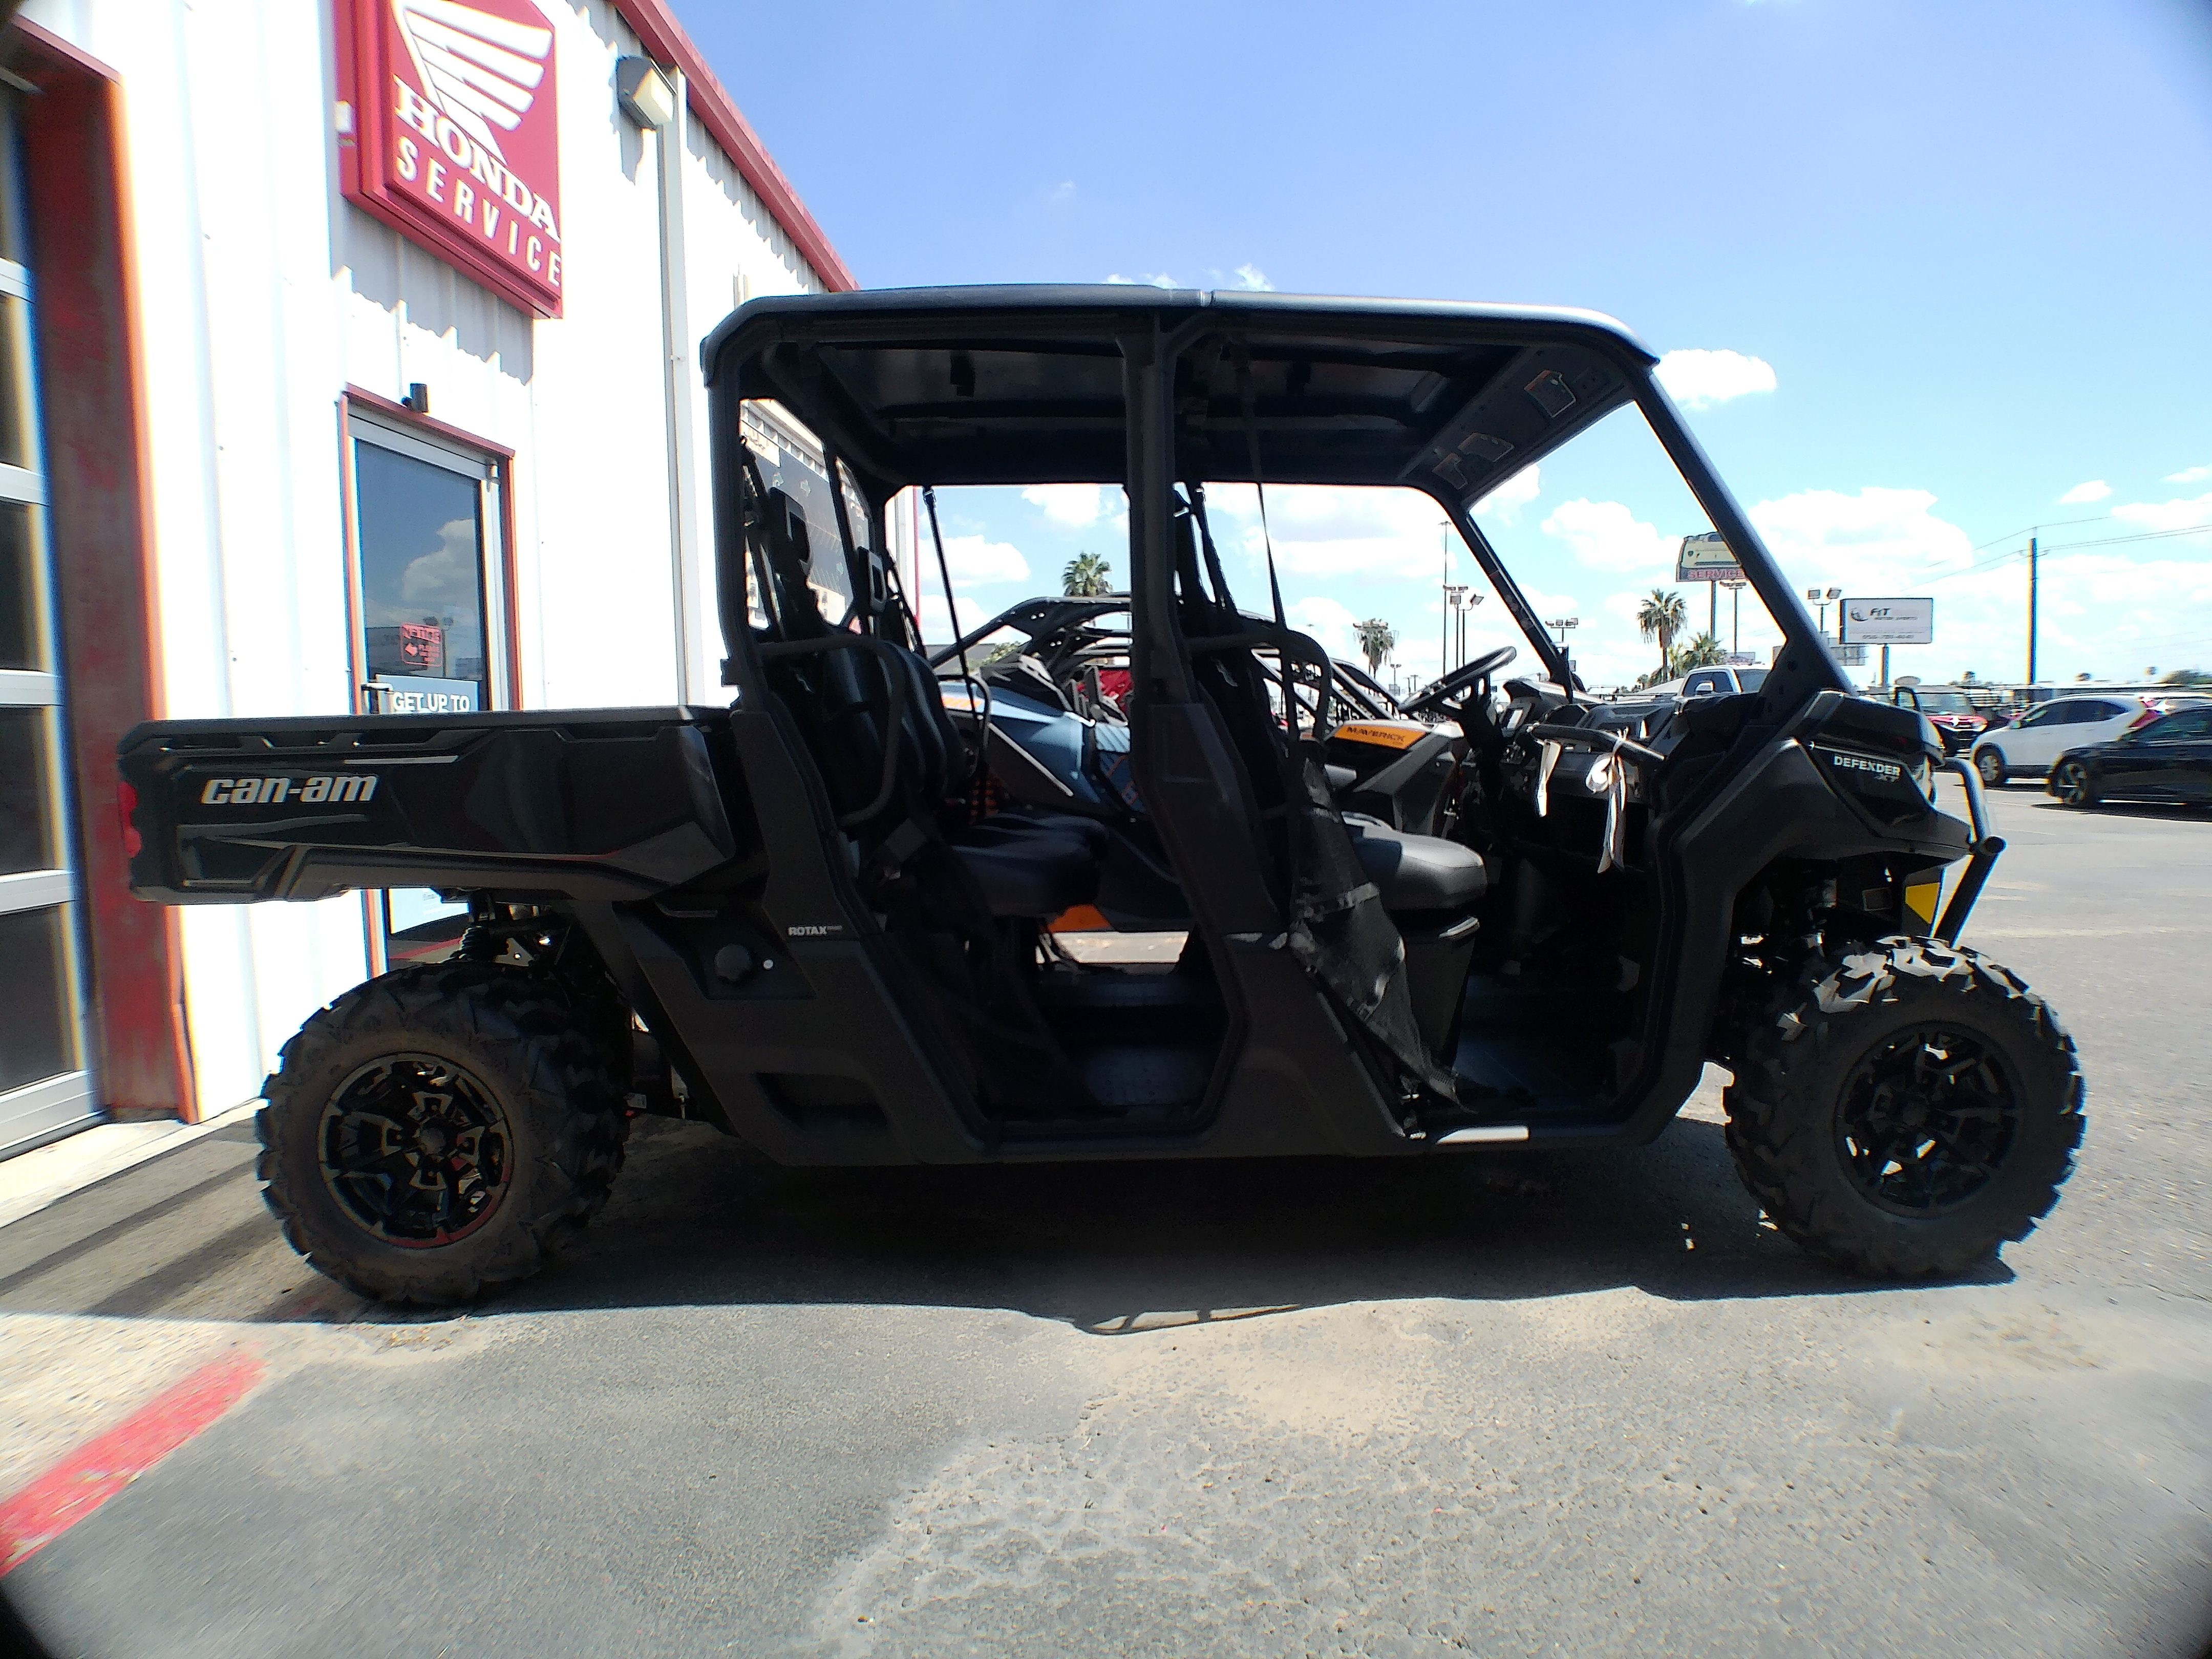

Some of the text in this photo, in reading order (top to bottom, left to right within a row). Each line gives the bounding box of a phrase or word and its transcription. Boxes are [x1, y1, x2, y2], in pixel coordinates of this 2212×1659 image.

[393, 74, 561, 243] HONDA
[397, 135, 561, 287] SERVICE
[393, 692, 470, 712] GET UP TO
[1346, 727, 1406, 741] MAVERICK
[1834, 755, 1901, 776] DEFENDER
[788, 926, 827, 936] ROTAX
